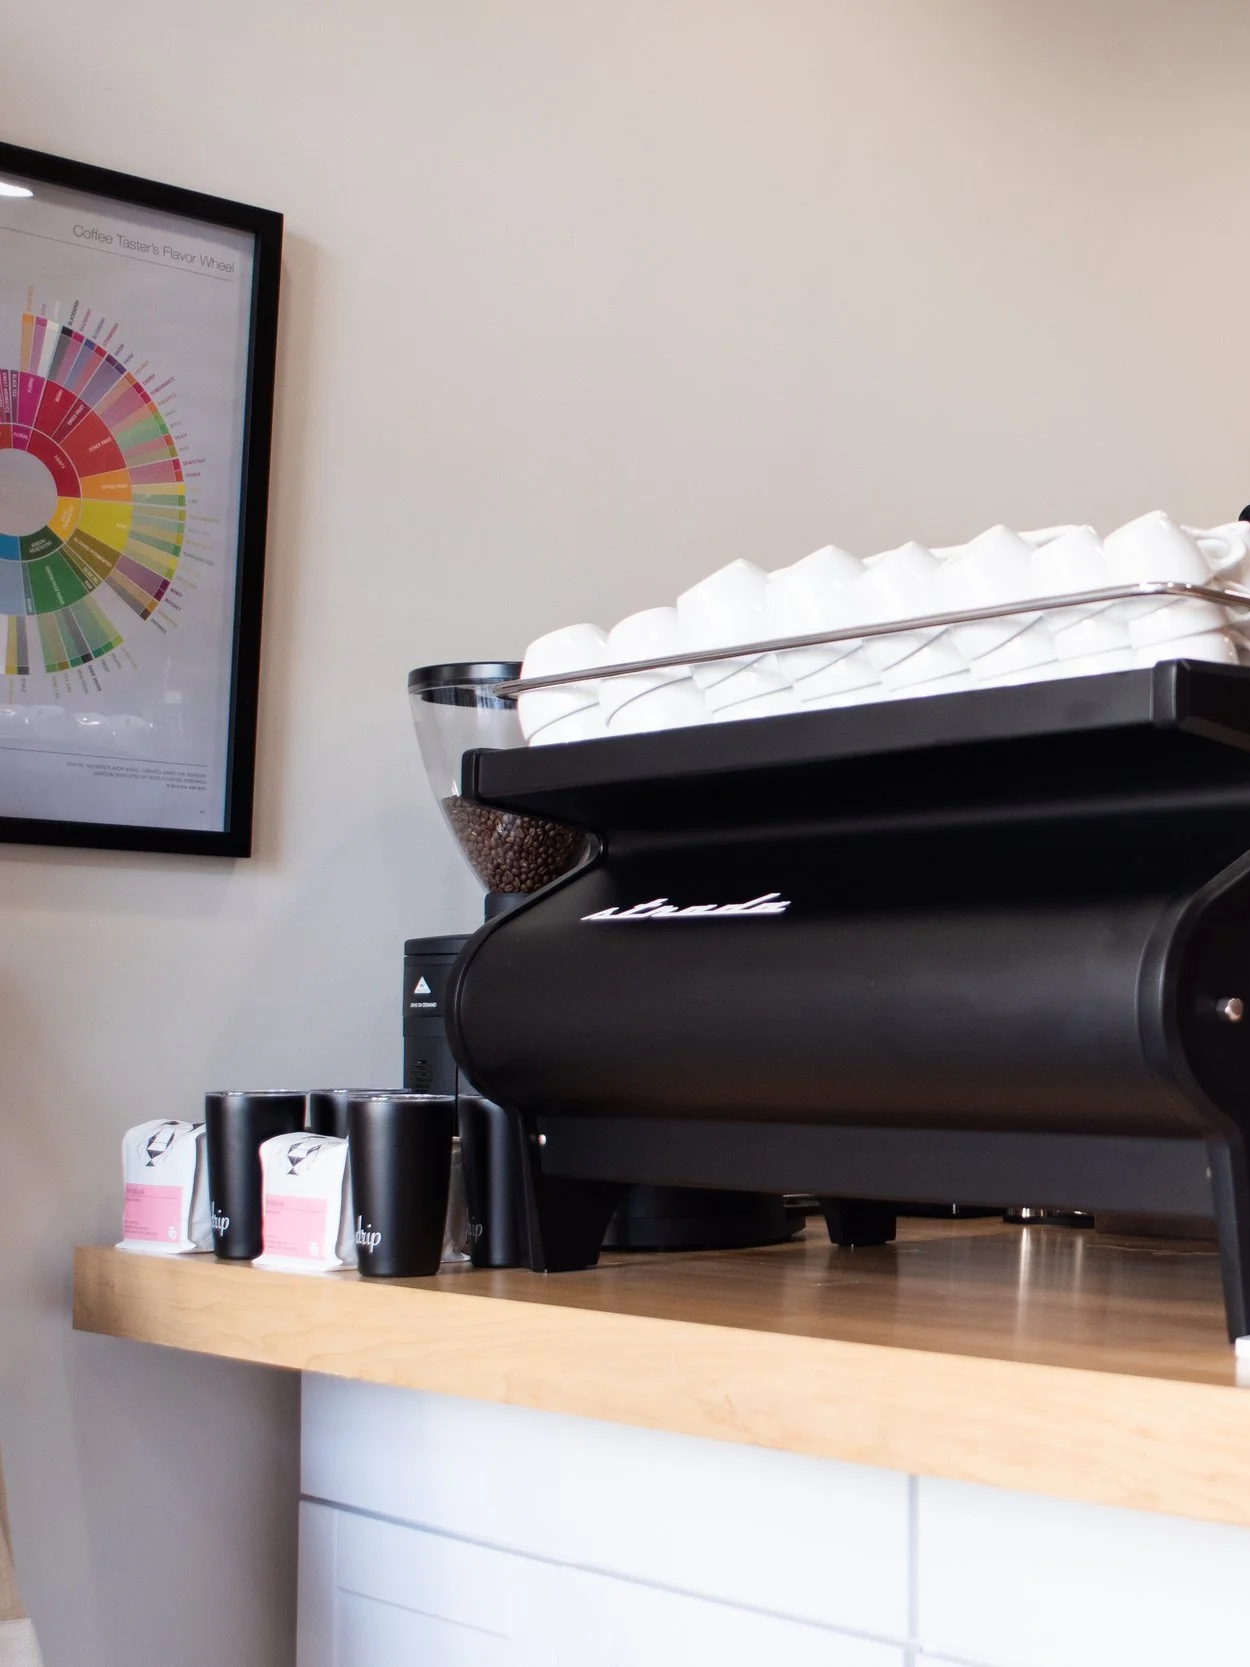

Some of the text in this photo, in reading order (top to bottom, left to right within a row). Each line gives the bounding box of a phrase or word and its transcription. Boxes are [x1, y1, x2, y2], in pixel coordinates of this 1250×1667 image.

[73, 224, 235, 274] Coffee Taster's Flavor Wheel
[355, 1214, 382, 1253] drip
